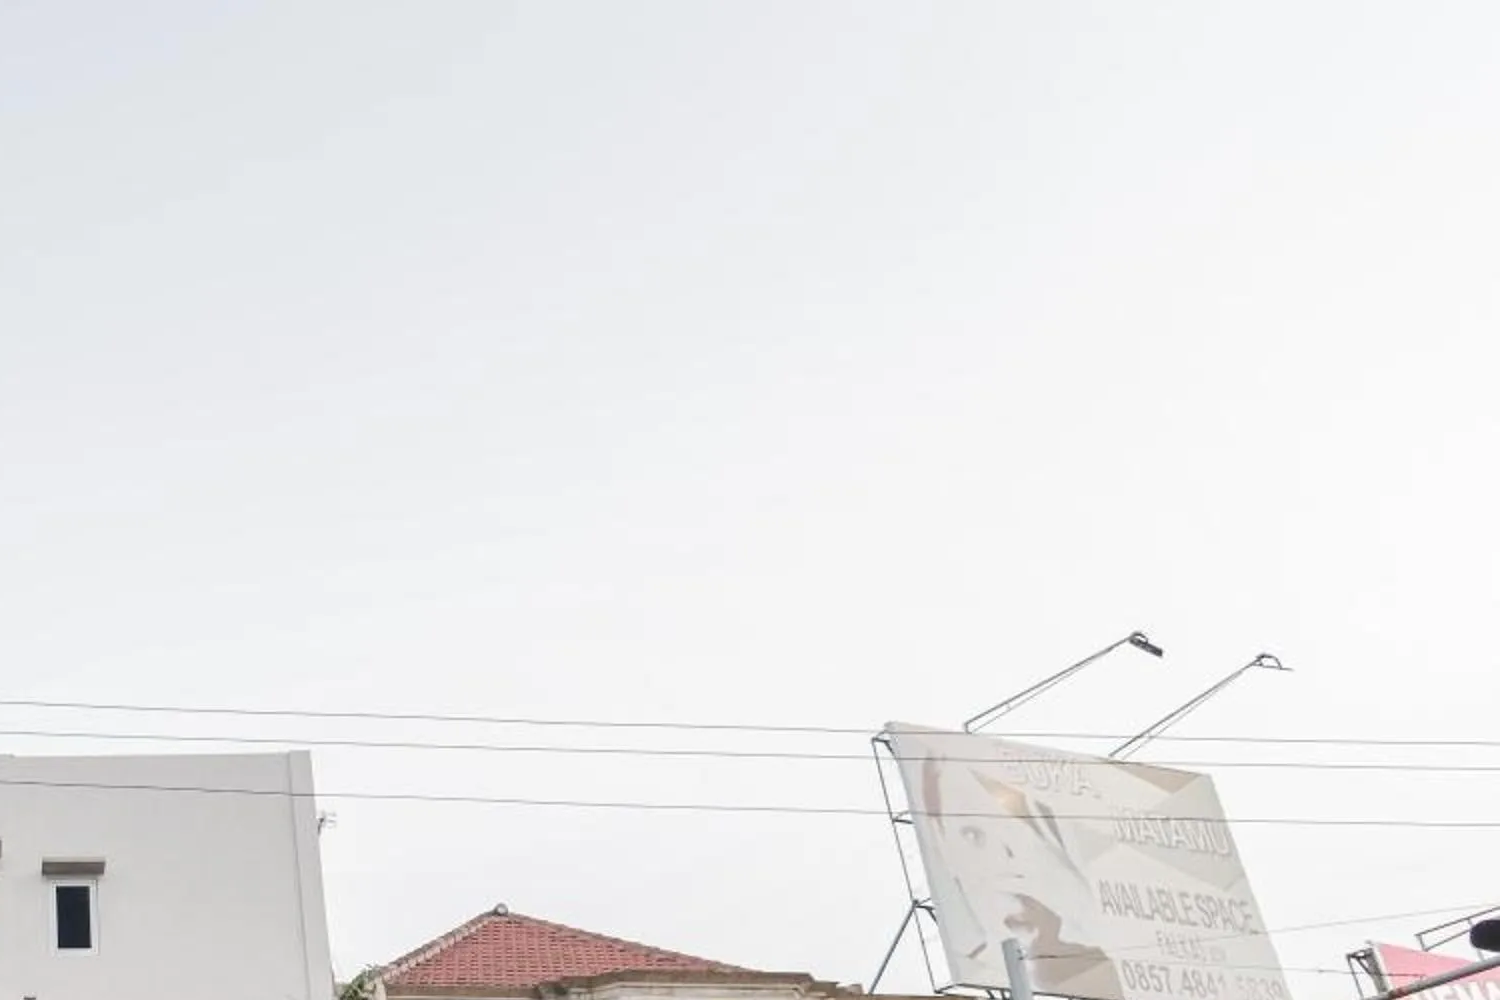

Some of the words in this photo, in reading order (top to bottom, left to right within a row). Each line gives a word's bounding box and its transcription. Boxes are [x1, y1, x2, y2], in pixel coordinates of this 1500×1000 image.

[1099, 880, 1198, 927] AVAILABLE
[1198, 894, 1252, 933] SPACE
[1122, 960, 1173, 994] 0857
